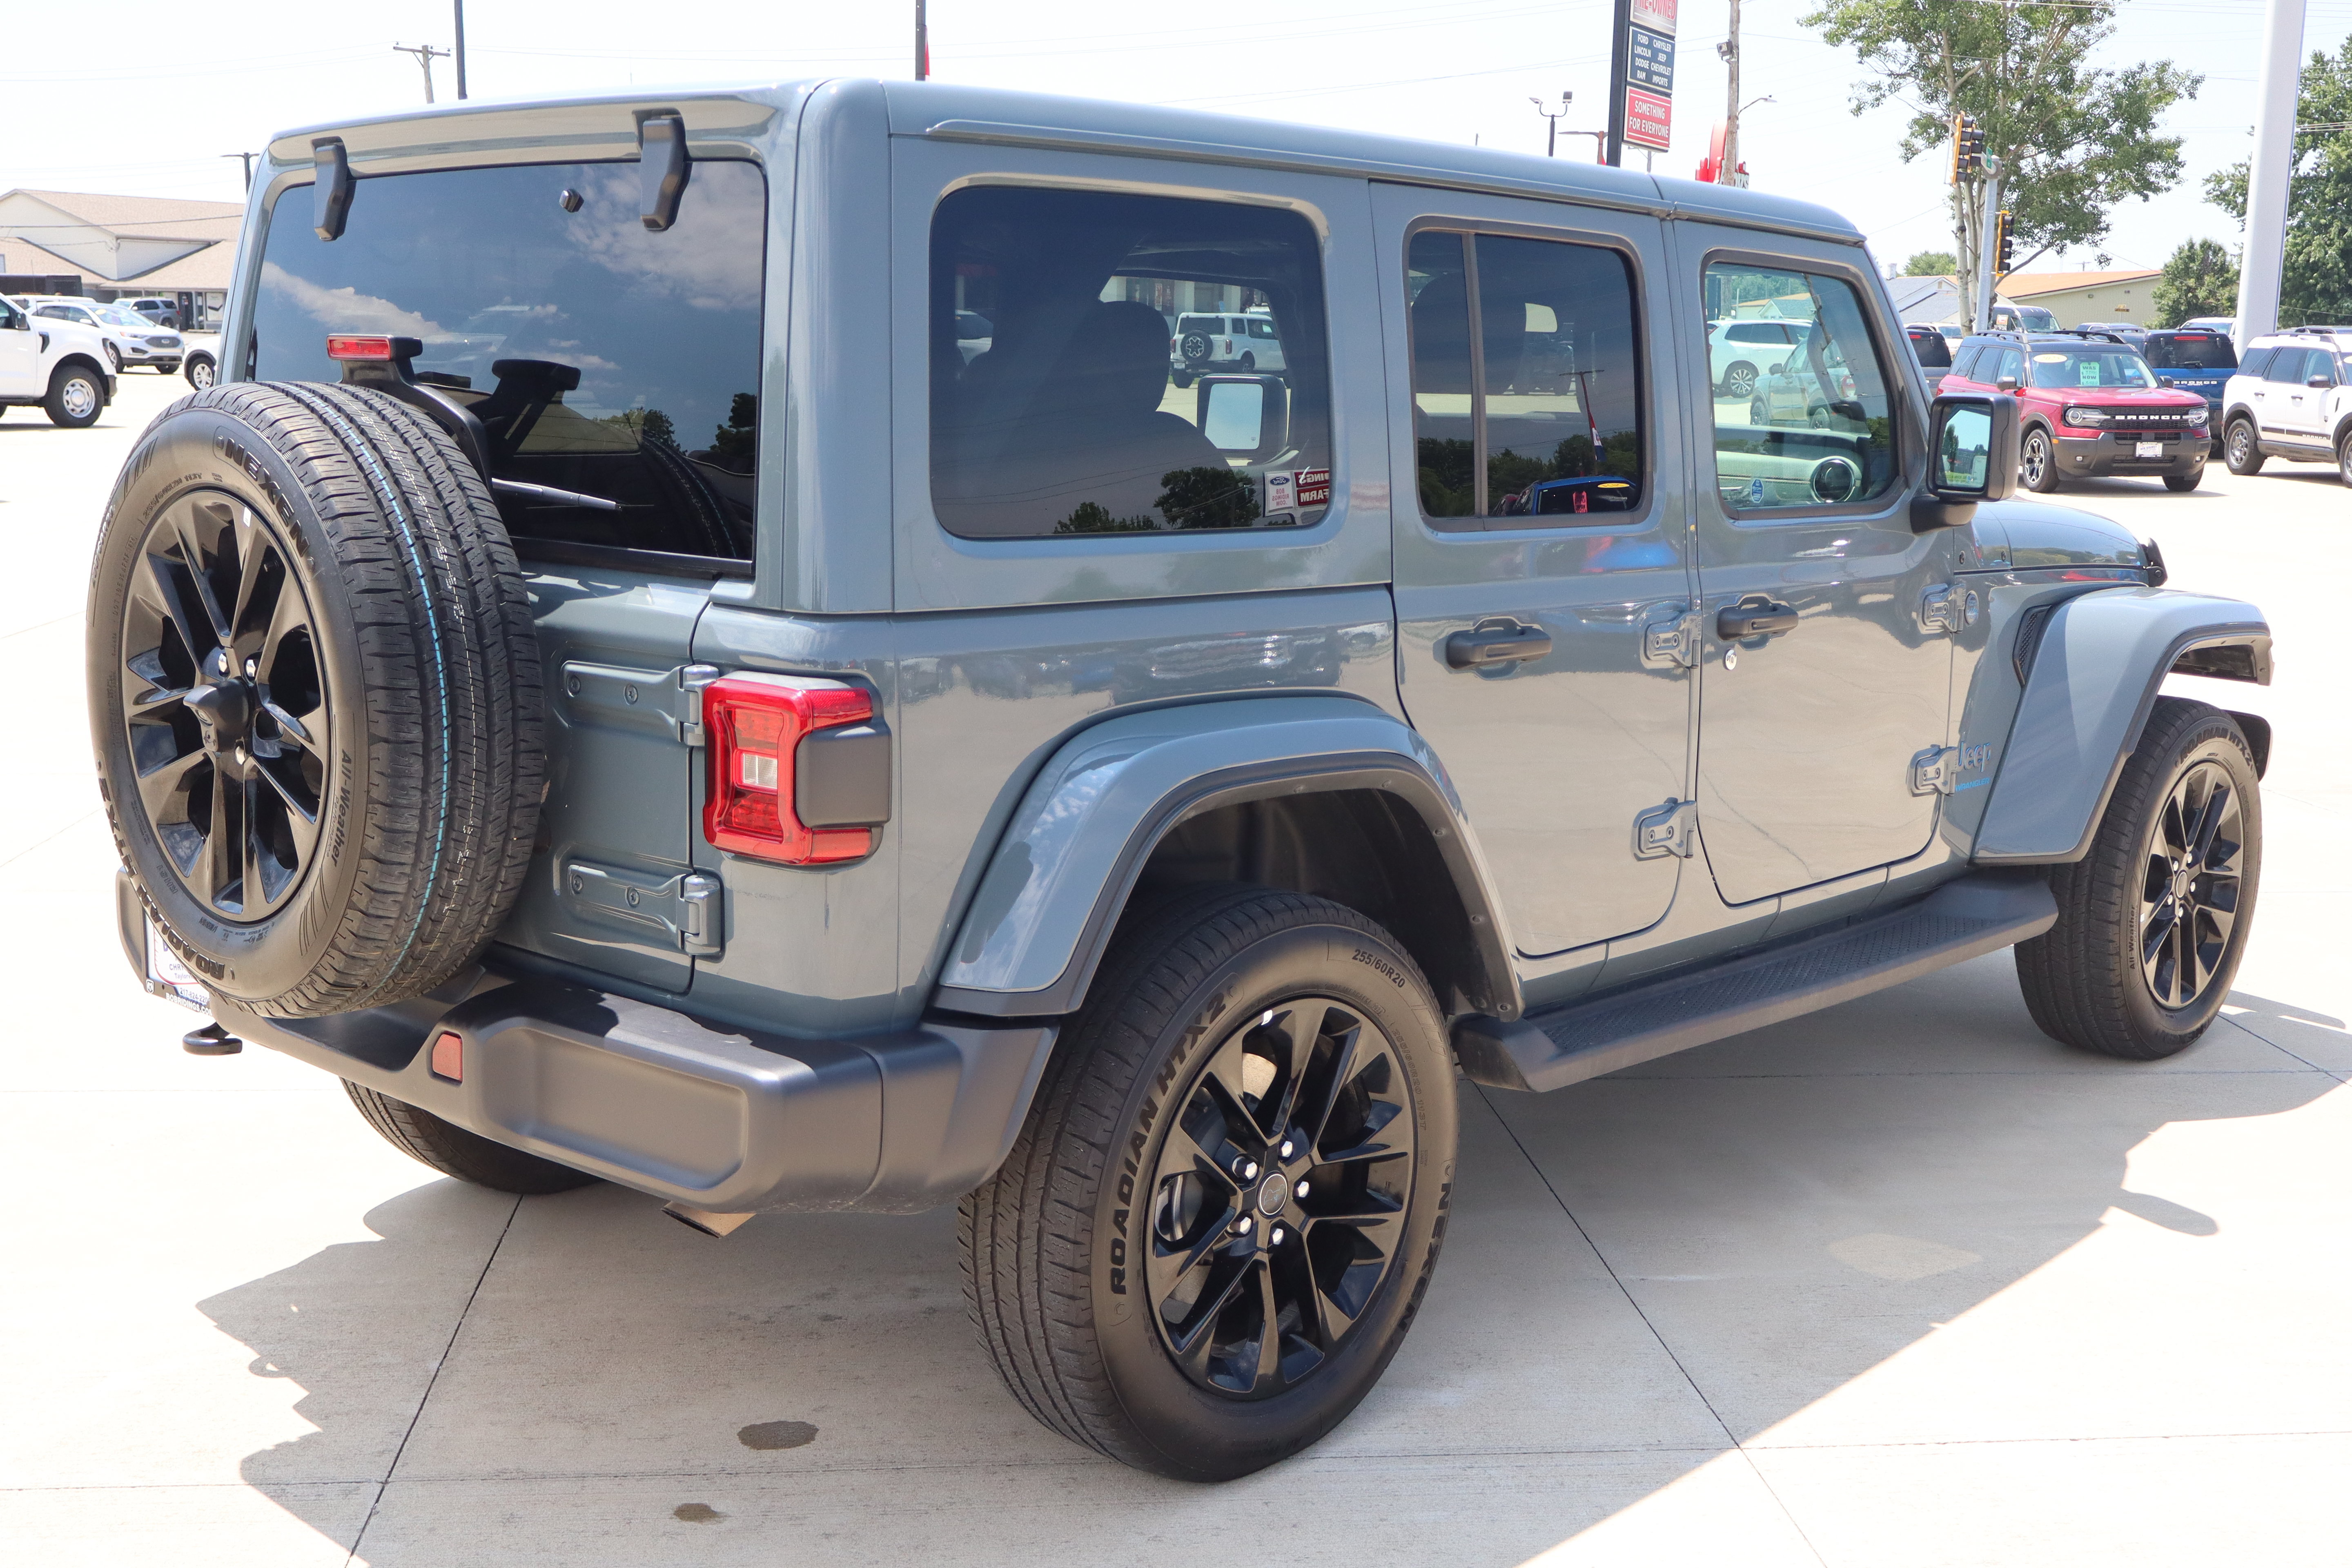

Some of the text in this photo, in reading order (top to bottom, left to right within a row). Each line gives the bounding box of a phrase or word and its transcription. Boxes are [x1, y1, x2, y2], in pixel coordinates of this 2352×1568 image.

[1635, 45, 1666, 62] LINCOLN JEEP
[1638, 34, 1671, 52] FORD CHRYSLER
[1635, 57, 1671, 76] DODGE CHEVROLET
[1637, 70, 1668, 87] RAM IMPORTS
[1629, 116, 1669, 138] FOR EVERYONE
[1635, 100, 1665, 119] SOMETHING
[143, 472, 202, 519] 255/60R20 113T
[225, 437, 311, 558] NEXEN
[1958, 741, 1991, 773] Jeep
[2180, 727, 2229, 764] ROADIAN
[1955, 777, 1991, 792] WRANGLER
[331, 748, 352, 867] All-Weather
[137, 883, 225, 981] ROADIAN
[1352, 949, 1406, 988] 255/60R20
[1392, 1029, 1426, 1131] 255/60R20 113T
[1109, 1095, 1159, 1295] ROADIAN
[1398, 1183, 1452, 1332] NEXEN
